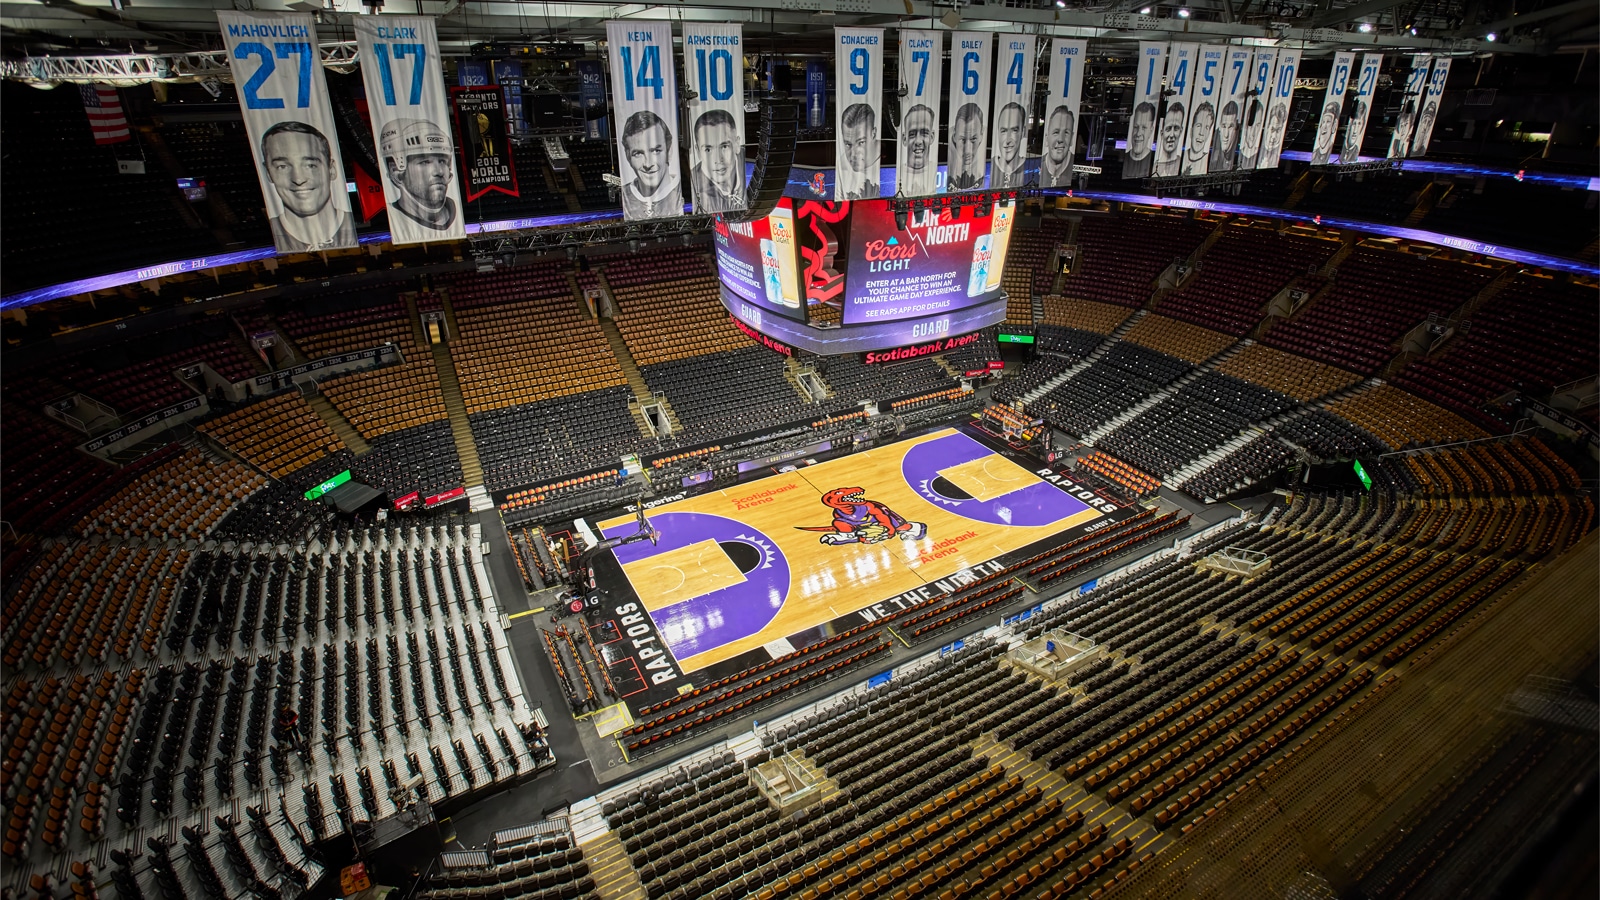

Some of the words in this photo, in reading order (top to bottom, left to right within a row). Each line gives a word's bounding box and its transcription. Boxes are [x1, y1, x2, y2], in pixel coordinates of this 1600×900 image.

[227, 24, 308, 38] MAHOVLICH
[377, 27, 417, 39] CLARK
[628, 31, 652, 42] KEON
[687, 35, 739, 45] ARMSTRONG
[841, 35, 878, 45] CONACHER
[909, 39, 934, 48] CLANCY
[961, 40, 983, 49] BAILEY
[1009, 42, 1025, 50] KELLY
[1060, 47, 1078, 55] BOWER
[234, 42, 312, 109] 27
[373, 43, 426, 105] 17
[583, 73, 600, 84] 942
[620, 46, 664, 100] 14
[696, 49, 733, 100] 10
[811, 72, 823, 81] 1951
[850, 48, 869, 95] 9
[912, 51, 930, 96] 7
[962, 52, 979, 95] 6
[1007, 53, 1024, 94] 4
[1063, 58, 1071, 98] 1
[1146, 58, 1155, 95] 1
[1173, 60, 1188, 95] 4
[1202, 61, 1217, 96] 5
[1231, 61, 1244, 95] 7
[1256, 62, 1269, 95] 9
[1276, 65, 1294, 97] 10
[1331, 65, 1348, 95] 13
[1360, 66, 1377, 95] 21
[1409, 68, 1428, 96] 27
[1429, 69, 1447, 95] 93
[471, 165, 509, 178] WORLD
[477, 157, 499, 167] 2019
[472, 175, 510, 185] CHAMPIONS
[926, 222, 970, 246] NORTH
[865, 239, 917, 261] Coors
[869, 259, 910, 273] LIGHT
[866, 280, 889, 288] ENTER
[906, 276, 919, 284] BAR
[920, 274, 943, 283] NORTH
[944, 271, 957, 279] FOR
[869, 287, 889, 295] YOUR
[890, 284, 919, 293] CHANCE
[930, 280, 943, 289] WIN
[943, 279, 952, 287] AN
[854, 296, 888, 304] ULTIMATE
[889, 292, 909, 301] GAME
[910, 290, 924, 299] DAY
[924, 285, 962, 297] EXPERIENCE.
[742, 303, 762, 325] GUARD
[880, 307, 897, 316] RAPS
[898, 305, 911, 314] APP
[912, 304, 926, 312] FOR
[927, 300, 950, 310] DETAILS
[912, 319, 950, 337] GUARD
[763, 335, 792, 357] Arena
[865, 340, 942, 364] Scotiabank
[945, 332, 979, 350] Arena
[276, 371, 290, 379] IBM
[294, 366, 308, 375] IBM
[312, 361, 325, 370] IBM
[329, 357, 342, 365] IBM
[346, 354, 359, 362] IBM
[363, 350, 376, 358] IBM
[89, 439, 104, 450] IBM
[108, 431, 124, 442] IBM
[127, 422, 141, 433] IBM
[145, 414, 159, 425] IBM
[163, 407, 179, 417] IBM
[183, 400, 198, 410] IBM
[1054, 451, 1063, 459] LG
[731, 483, 798, 506] Scotiabank
[1036, 468, 1118, 513] RAPTORS
[737, 496, 774, 511] Arena
[920, 546, 959, 565] Arena
[858, 603, 892, 623] WE
[890, 586, 932, 610] THE
[934, 560, 1005, 594] NORTH
[615, 602, 678, 685] RAPTORS
